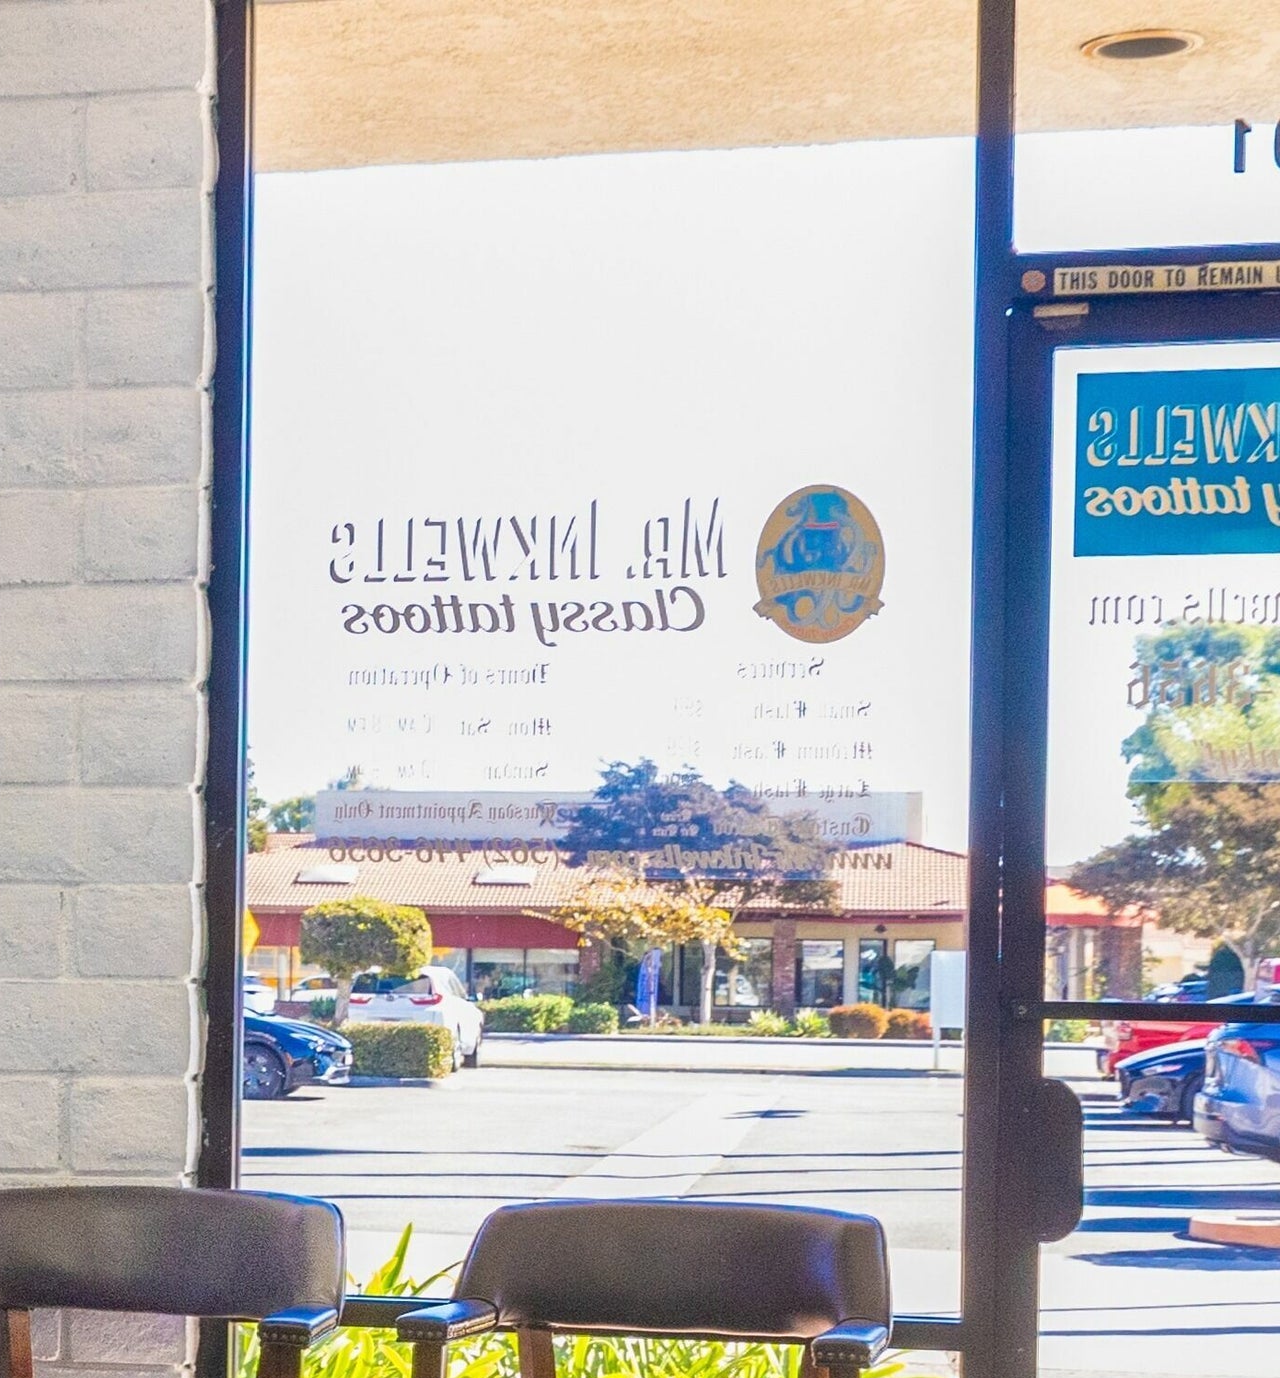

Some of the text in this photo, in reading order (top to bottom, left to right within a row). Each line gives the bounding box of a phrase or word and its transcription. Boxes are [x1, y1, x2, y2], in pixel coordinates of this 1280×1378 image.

[1059, 271, 1098, 291] THIS
[1107, 269, 1155, 290] DOOR
[1164, 268, 1186, 288] TO
[1197, 265, 1264, 287] REMAIN
